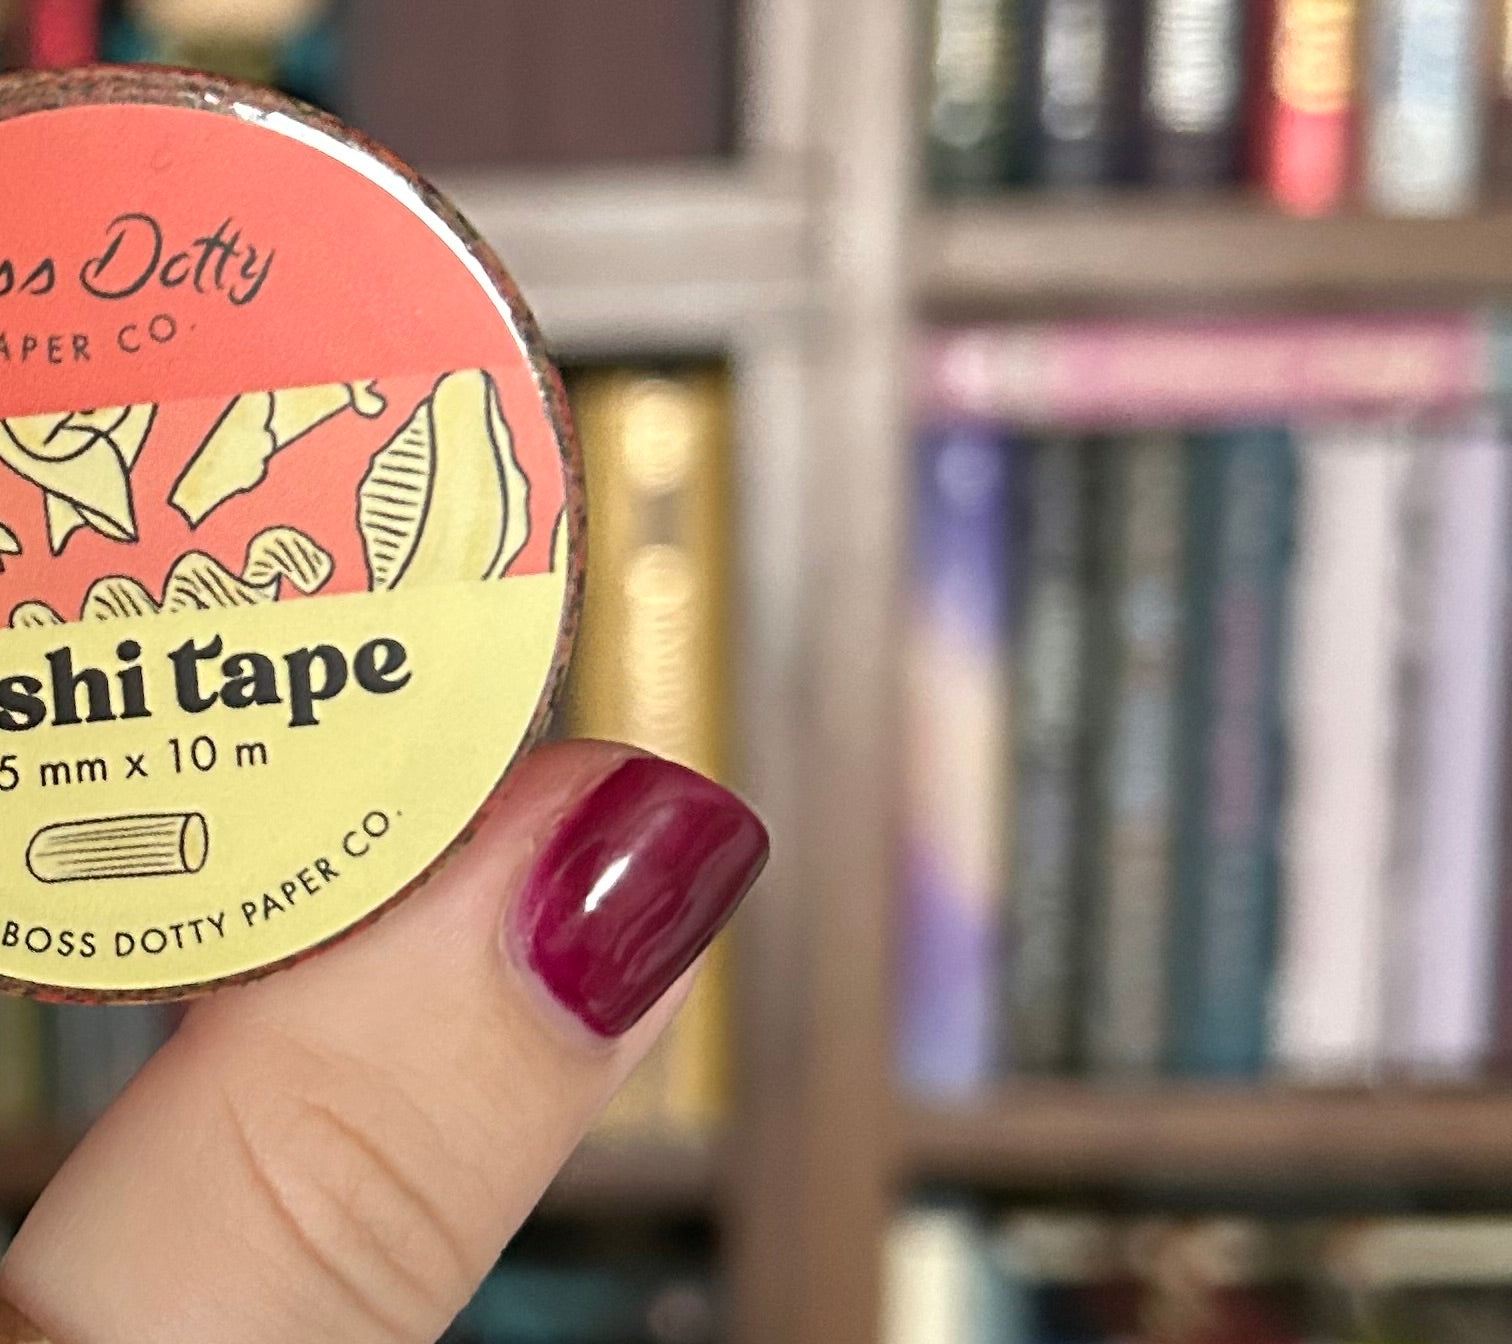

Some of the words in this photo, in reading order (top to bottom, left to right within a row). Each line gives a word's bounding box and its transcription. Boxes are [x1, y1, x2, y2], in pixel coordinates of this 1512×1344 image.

[79, 212, 276, 306] Dotty
[167, 633, 413, 728] tape
[39, 755, 108, 788] mm
[124, 754, 149, 780] x
[167, 734, 218, 774] 10
[235, 739, 270, 769] m
[1, 920, 98, 959] BOSS
[113, 911, 227, 958] DOTTY
[240, 857, 341, 927] PAPER
